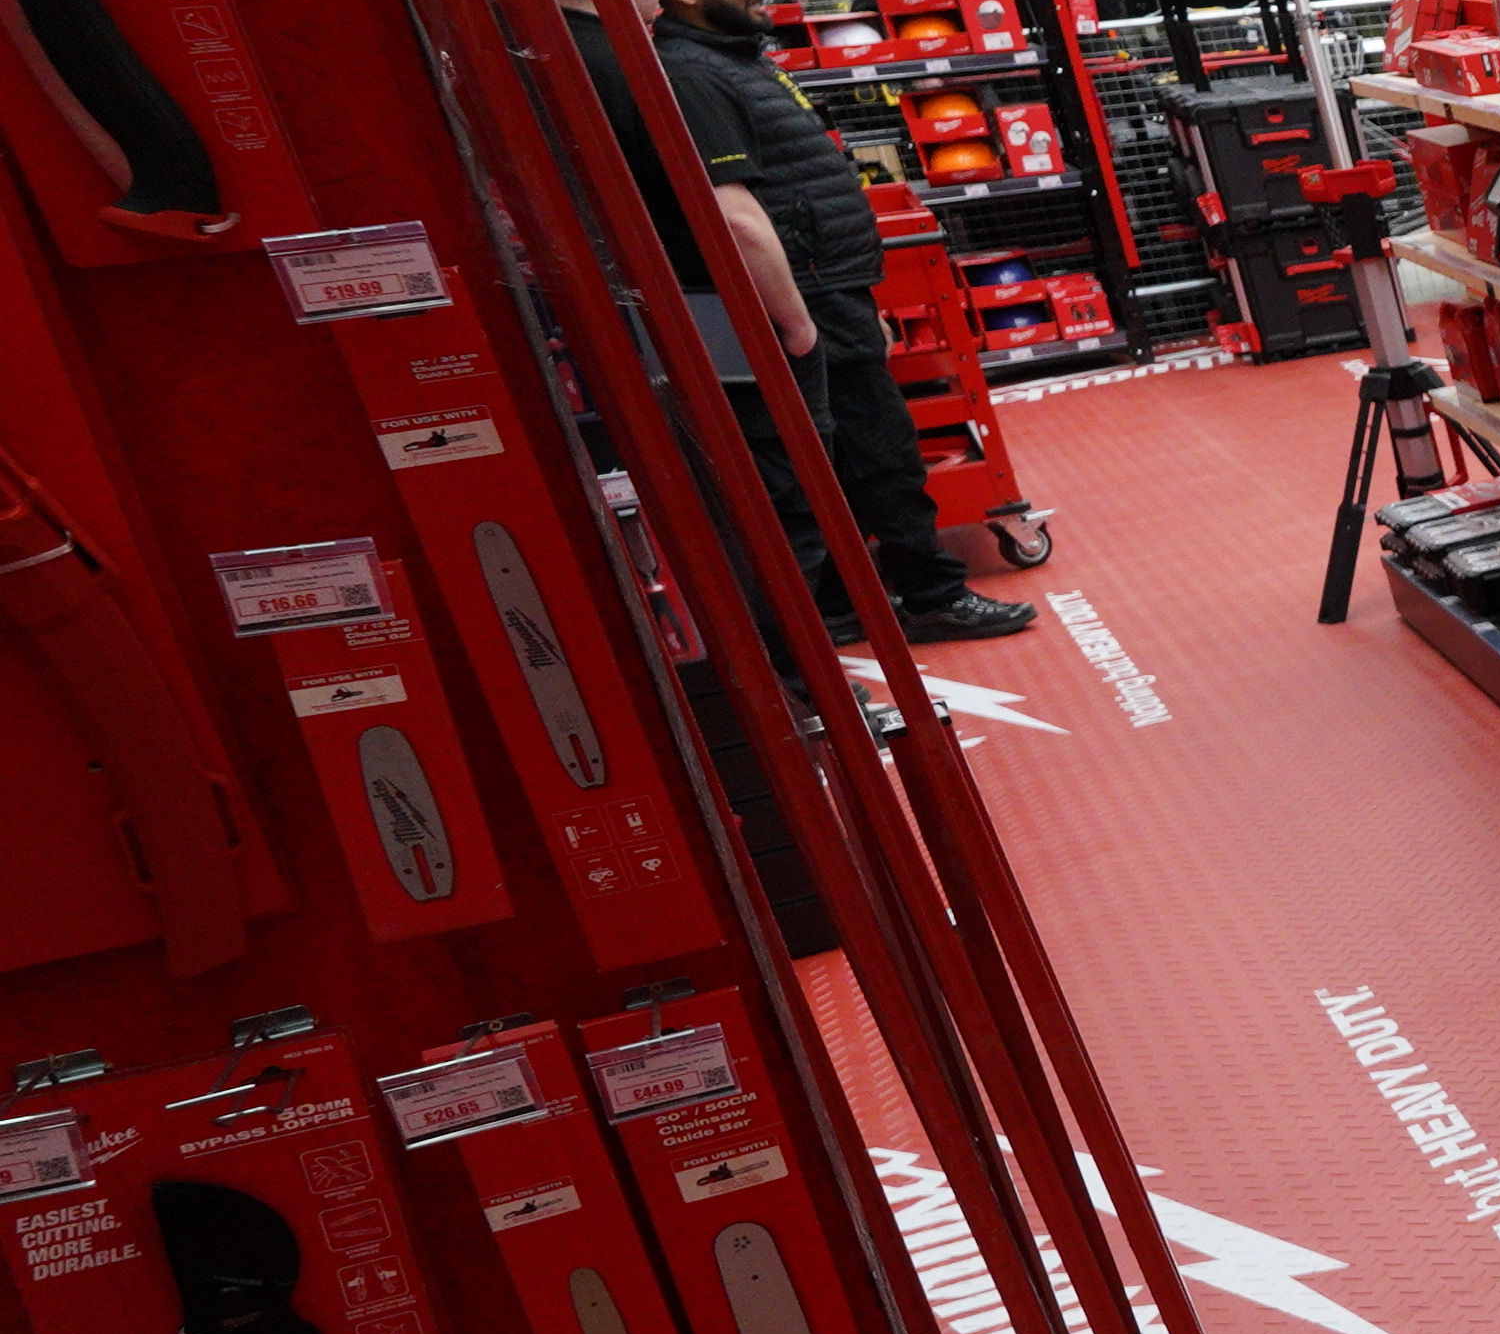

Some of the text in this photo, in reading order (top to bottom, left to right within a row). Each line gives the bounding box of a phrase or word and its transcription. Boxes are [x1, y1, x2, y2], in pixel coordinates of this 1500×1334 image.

[411, 415, 441, 426] USE
[445, 409, 479, 420] WITH
[706, 1092, 758, 1111] 50CM
[180, 1107, 355, 1154] BYPASS LOPPER
[658, 1107, 747, 1136] Chainsaw
[662, 1117, 753, 1147] Guide Bar
[683, 1140, 770, 1167] FOR USE WITH
[16, 1199, 110, 1233] EASIEST
[22, 1219, 122, 1249] CUTTING.
[27, 1237, 93, 1266] MORE
[32, 1243, 143, 1282] DURABLE.
